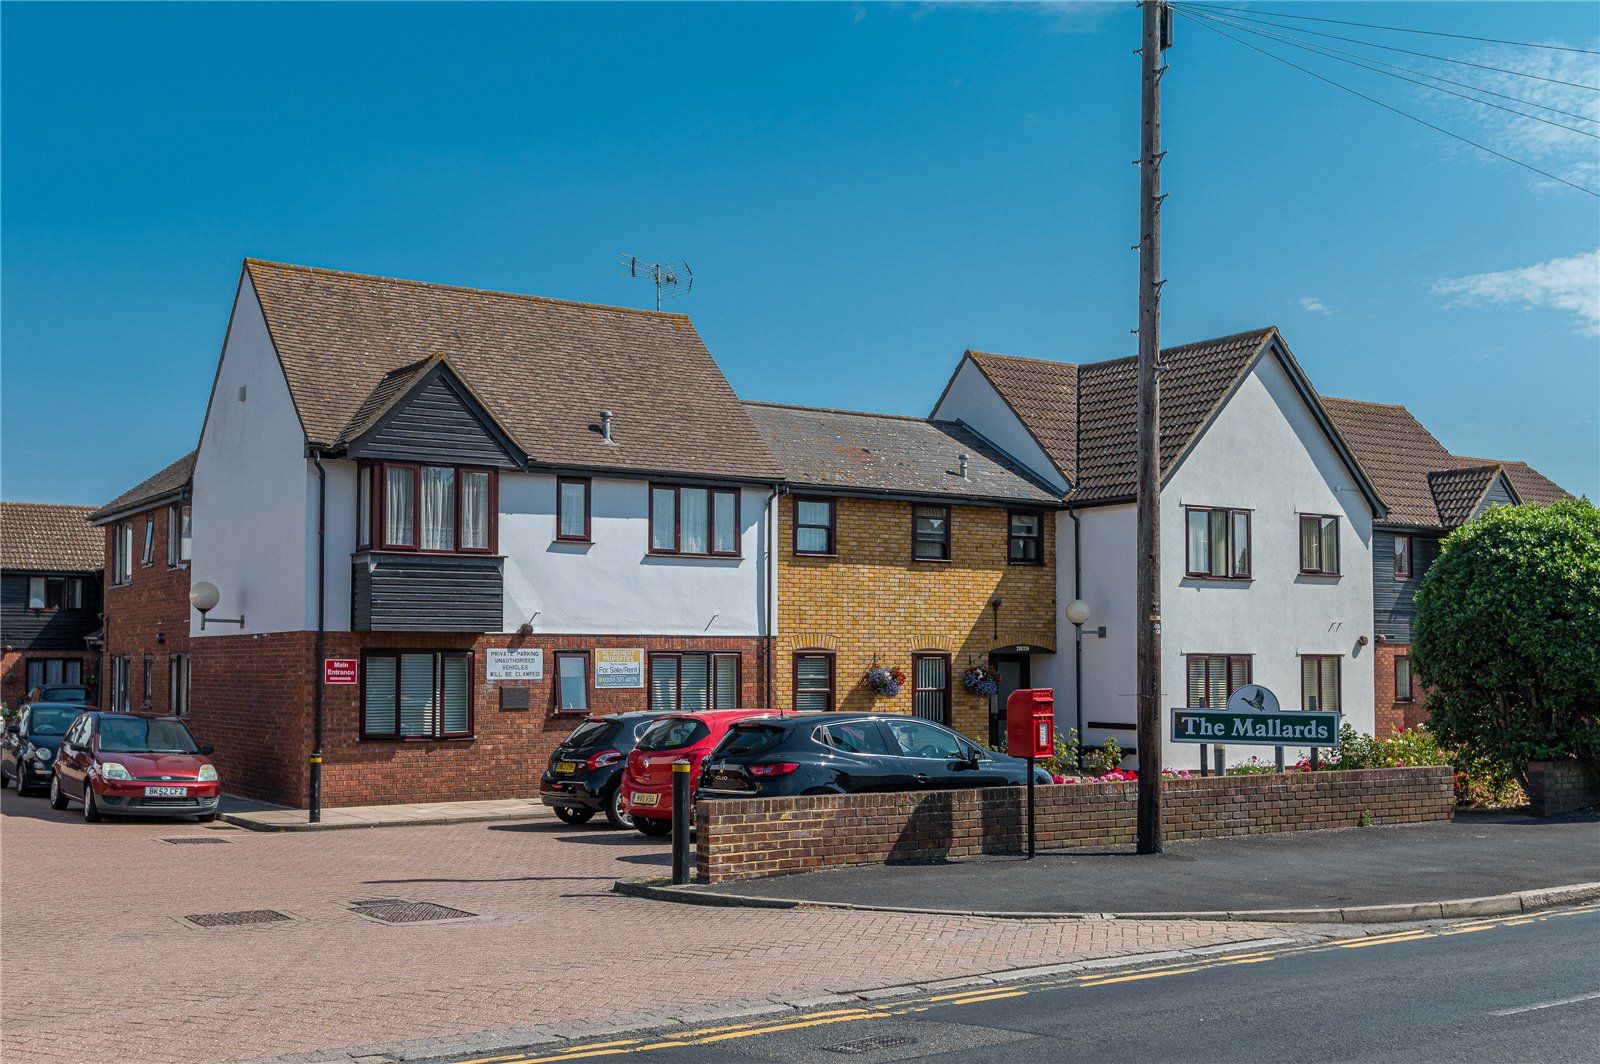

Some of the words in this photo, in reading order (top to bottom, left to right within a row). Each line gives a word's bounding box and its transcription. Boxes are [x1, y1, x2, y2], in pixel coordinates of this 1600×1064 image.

[610, 666, 638, 674] Sale/Rent
[1181, 716, 1226, 736] The
[1231, 718, 1329, 739] Mallards
[149, 787, 168, 795] BK52
[170, 787, 184, 795] CFZ
